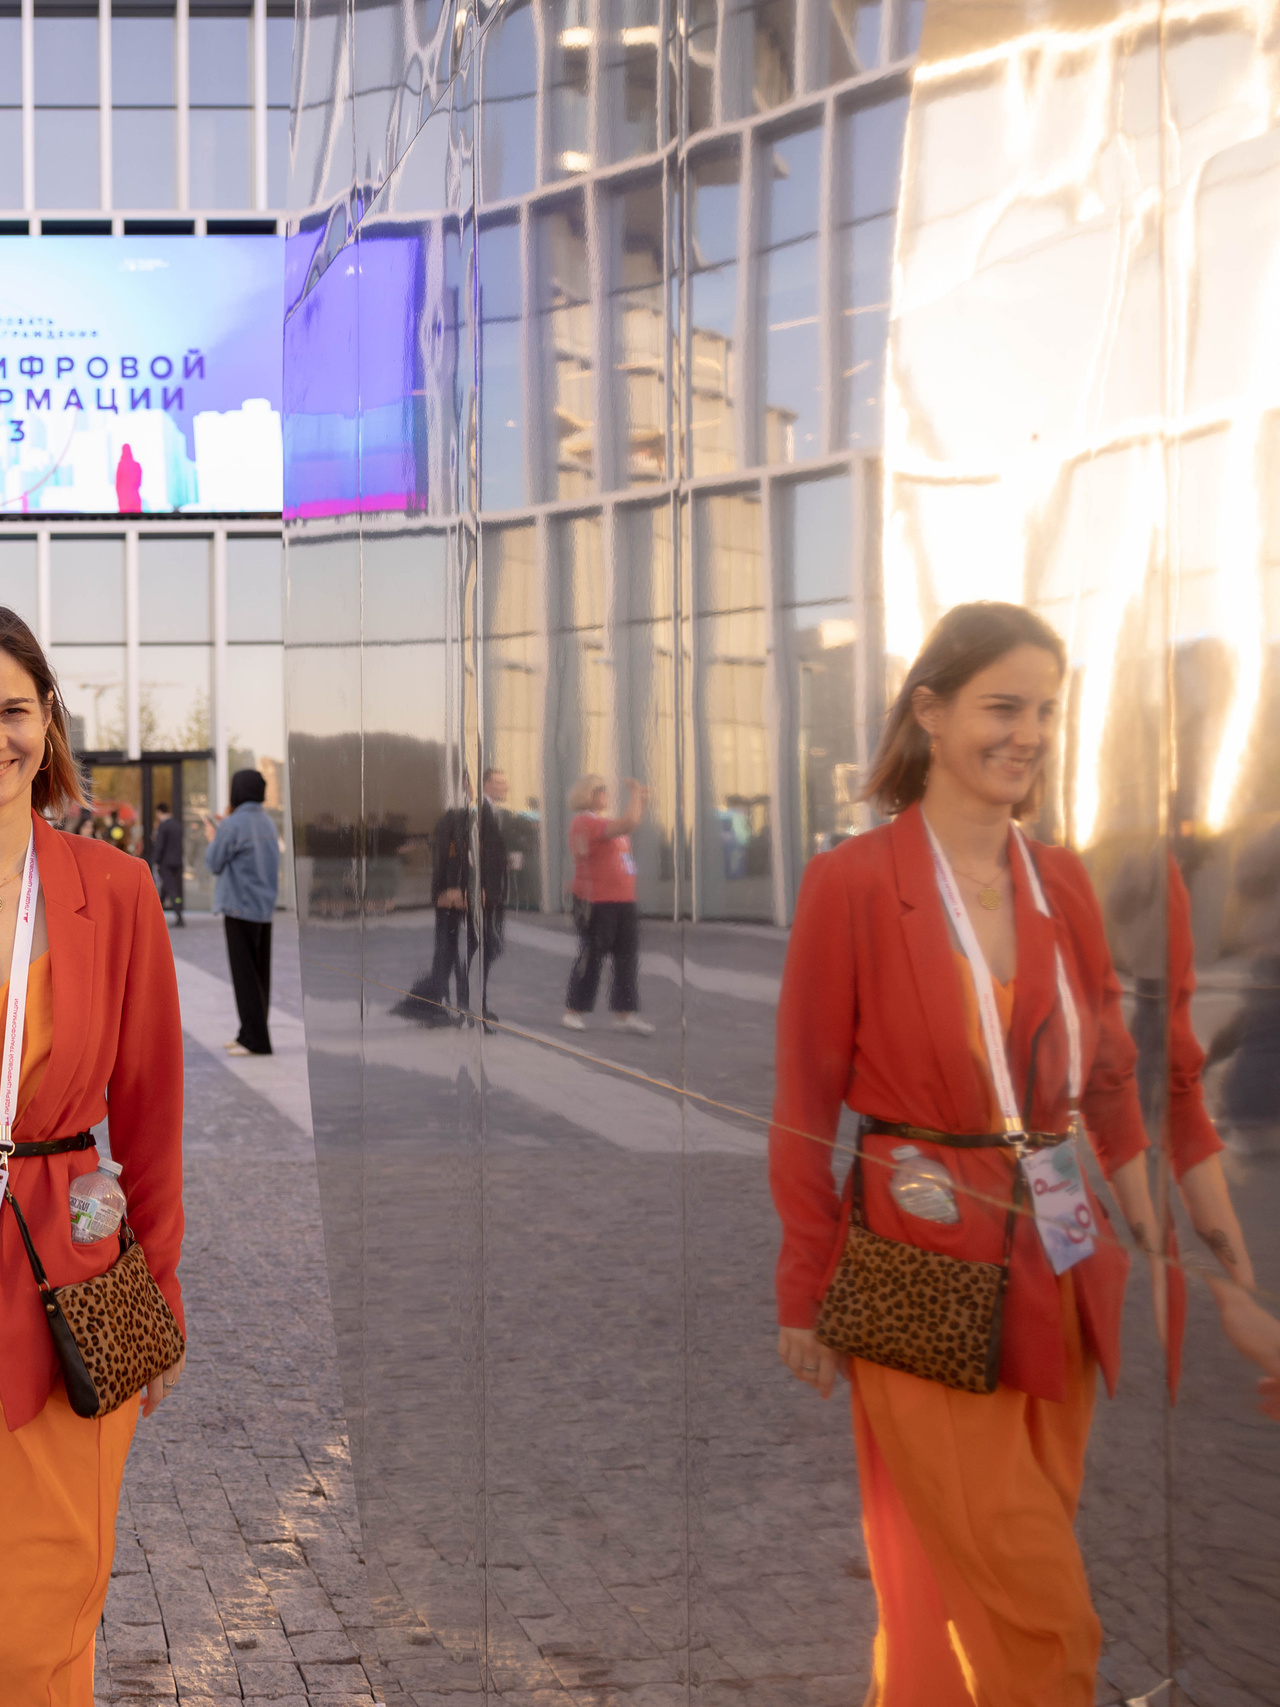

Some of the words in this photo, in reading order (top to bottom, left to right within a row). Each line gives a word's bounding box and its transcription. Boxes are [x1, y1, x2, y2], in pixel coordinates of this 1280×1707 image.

[27, 858, 35, 888] ЦИФРОВОЙ
[24, 888, 32, 911] ЛИДЕРЫ
[6, 1053, 14, 1088] ЦИФРОВОЙ
[10, 998, 19, 1052] ТРАНСФОРМАЦИИ
